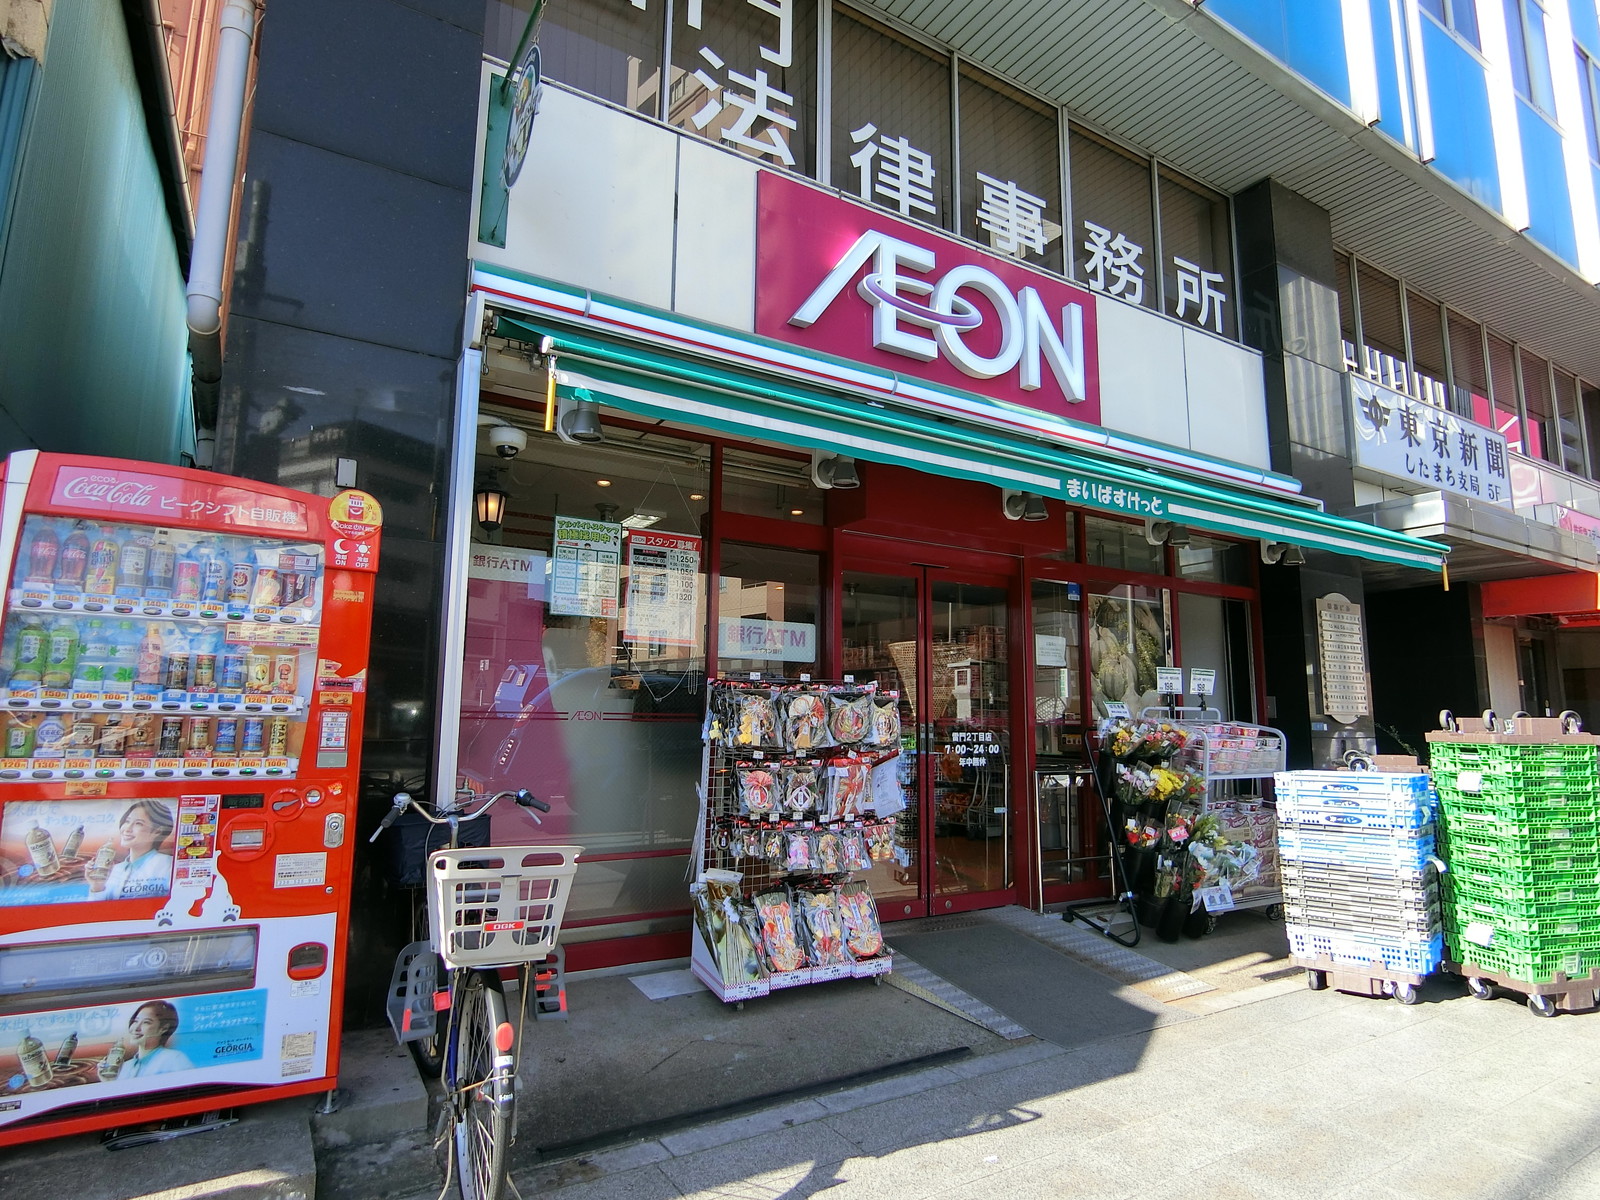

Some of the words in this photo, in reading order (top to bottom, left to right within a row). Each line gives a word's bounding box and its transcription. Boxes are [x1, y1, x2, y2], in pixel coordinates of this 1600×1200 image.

[691, 46, 1226, 334] 法律事務所
[1400, 404, 1506, 480] 東京新聞
[1405, 453, 1481, 496] したまち支局
[1488, 482, 1501, 502] 5F
[160, 496, 298, 525] ピークシフト自販機
[1066, 479, 1164, 516] まいばすけっと
[473, 554, 533, 572] 銀行ATM
[727, 624, 806, 648] 銀行ATM
